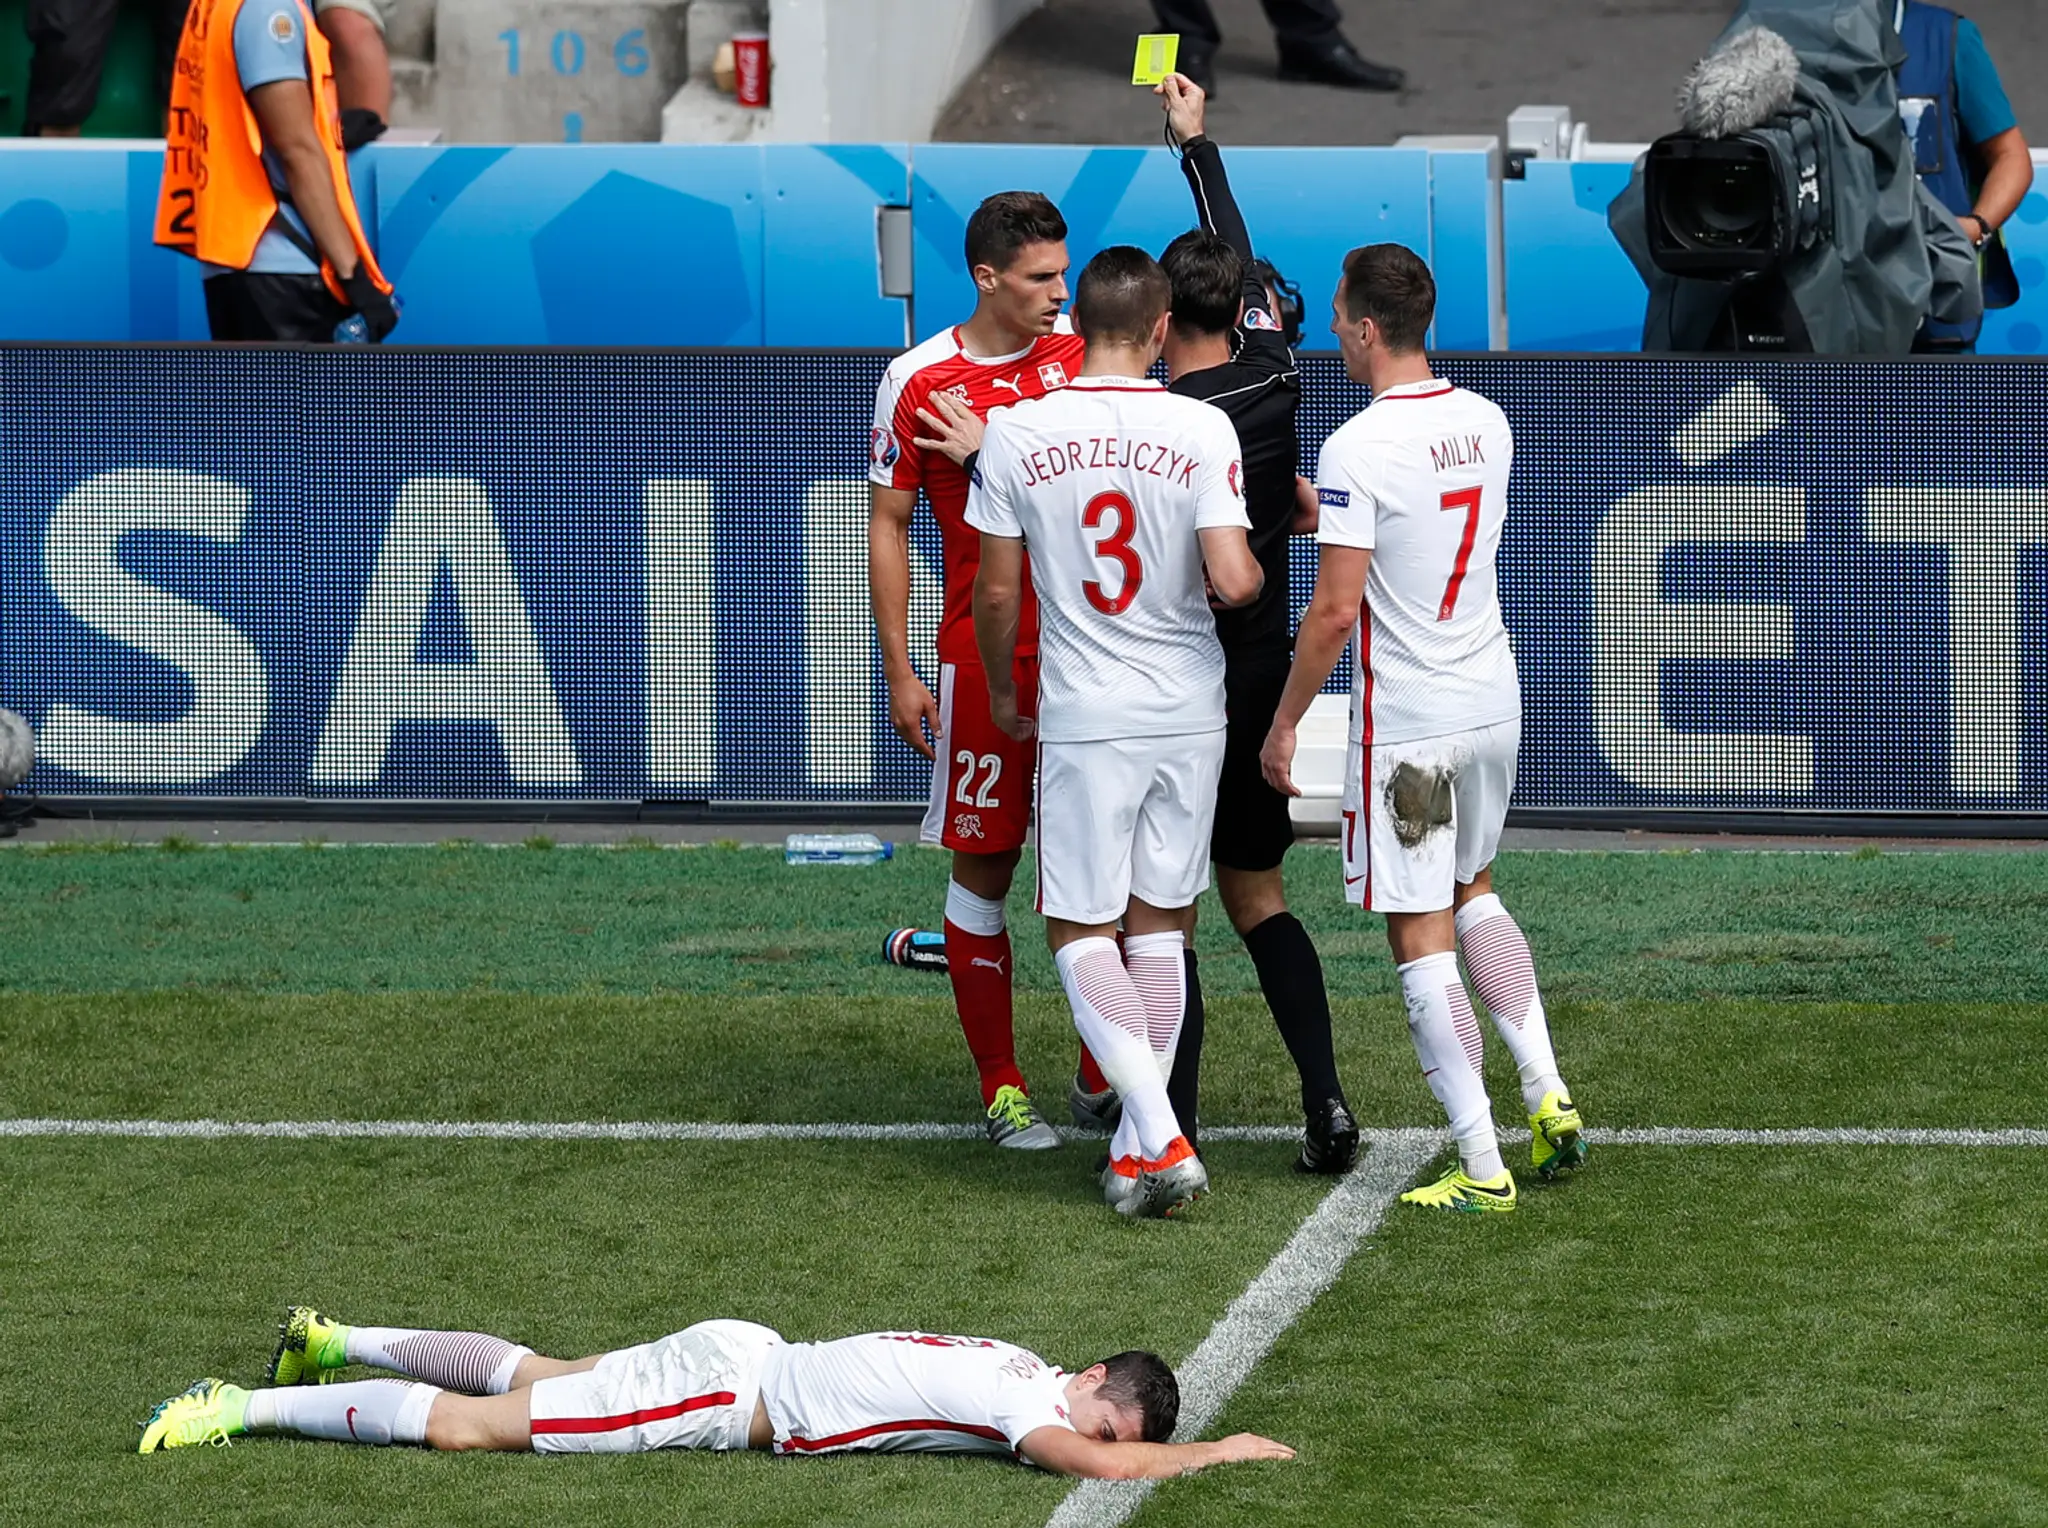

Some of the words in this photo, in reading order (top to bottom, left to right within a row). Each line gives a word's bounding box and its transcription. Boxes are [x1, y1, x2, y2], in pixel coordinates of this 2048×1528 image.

[1021, 438, 1200, 489] JĘDRZEJCZYK
[1430, 434, 1485, 473] MILIK
[1081, 489, 1143, 616] 3
[1437, 485, 1483, 622] 7
[956, 749, 1002, 808] 22
